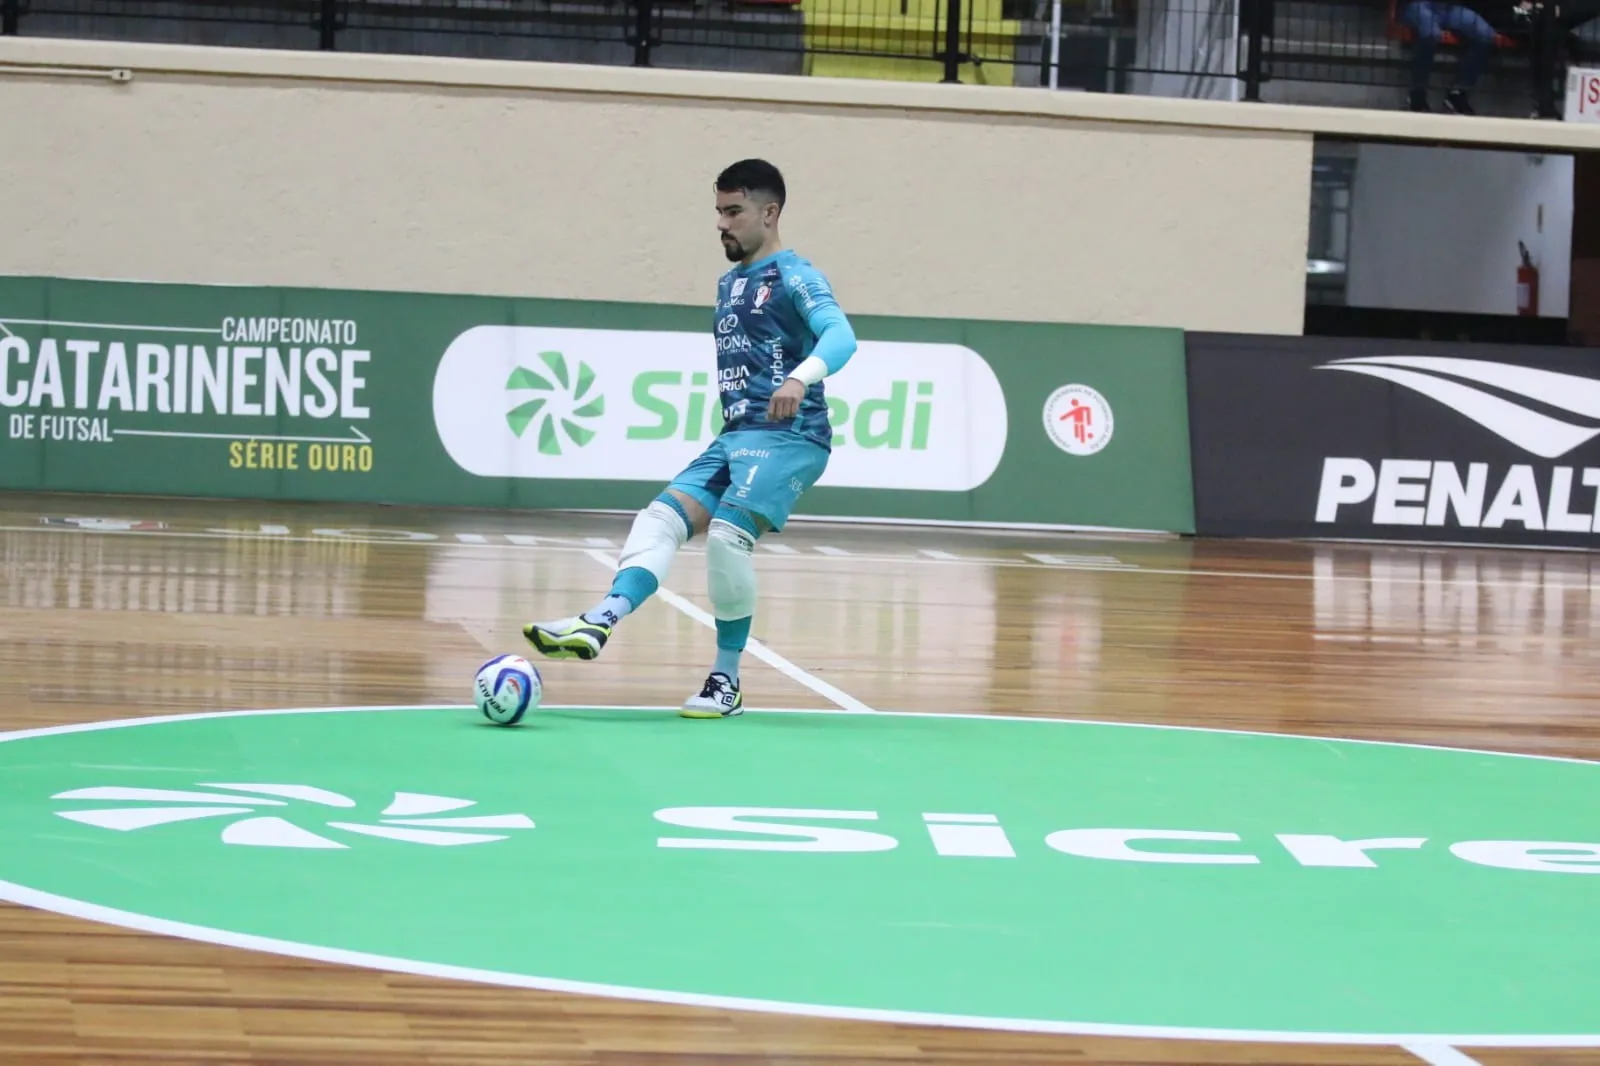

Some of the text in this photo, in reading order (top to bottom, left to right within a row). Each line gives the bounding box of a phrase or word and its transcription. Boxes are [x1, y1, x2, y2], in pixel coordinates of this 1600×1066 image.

[222, 316, 357, 345] CAMPEONATO
[715, 334, 752, 352] RONA
[0, 335, 371, 418] CATARINENSE
[626, 370, 934, 451] Siedi
[10, 414, 114, 442] DE FUTSAL
[229, 438, 373, 472] SÉRIE OURO
[746, 464, 759, 486] 1
